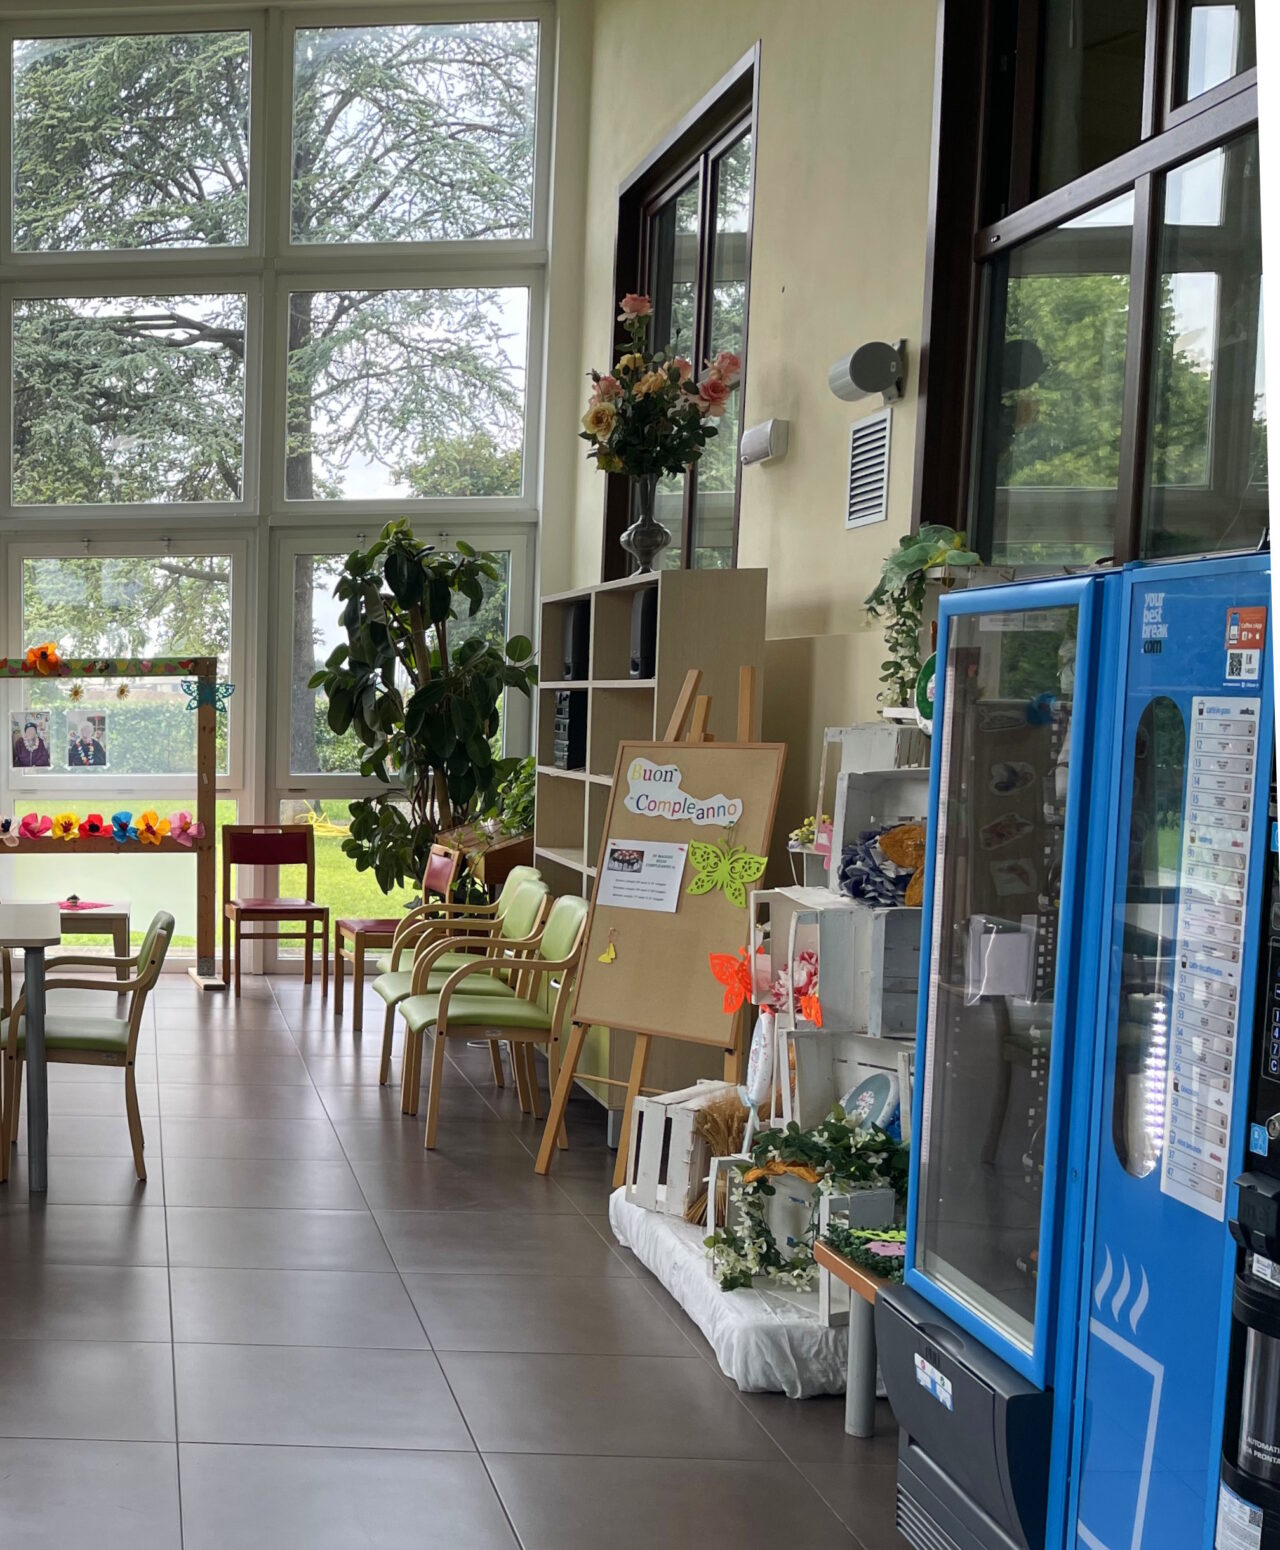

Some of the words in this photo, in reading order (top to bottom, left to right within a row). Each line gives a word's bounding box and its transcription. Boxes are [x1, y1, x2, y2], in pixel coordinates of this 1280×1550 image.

[1144, 592, 1165, 608] your
[1143, 607, 1162, 623] best
[1141, 623, 1168, 639] break
[631, 763, 674, 783] Buon
[636, 794, 737, 820] Compleanno
[1271, 1060, 1277, 1071] C
